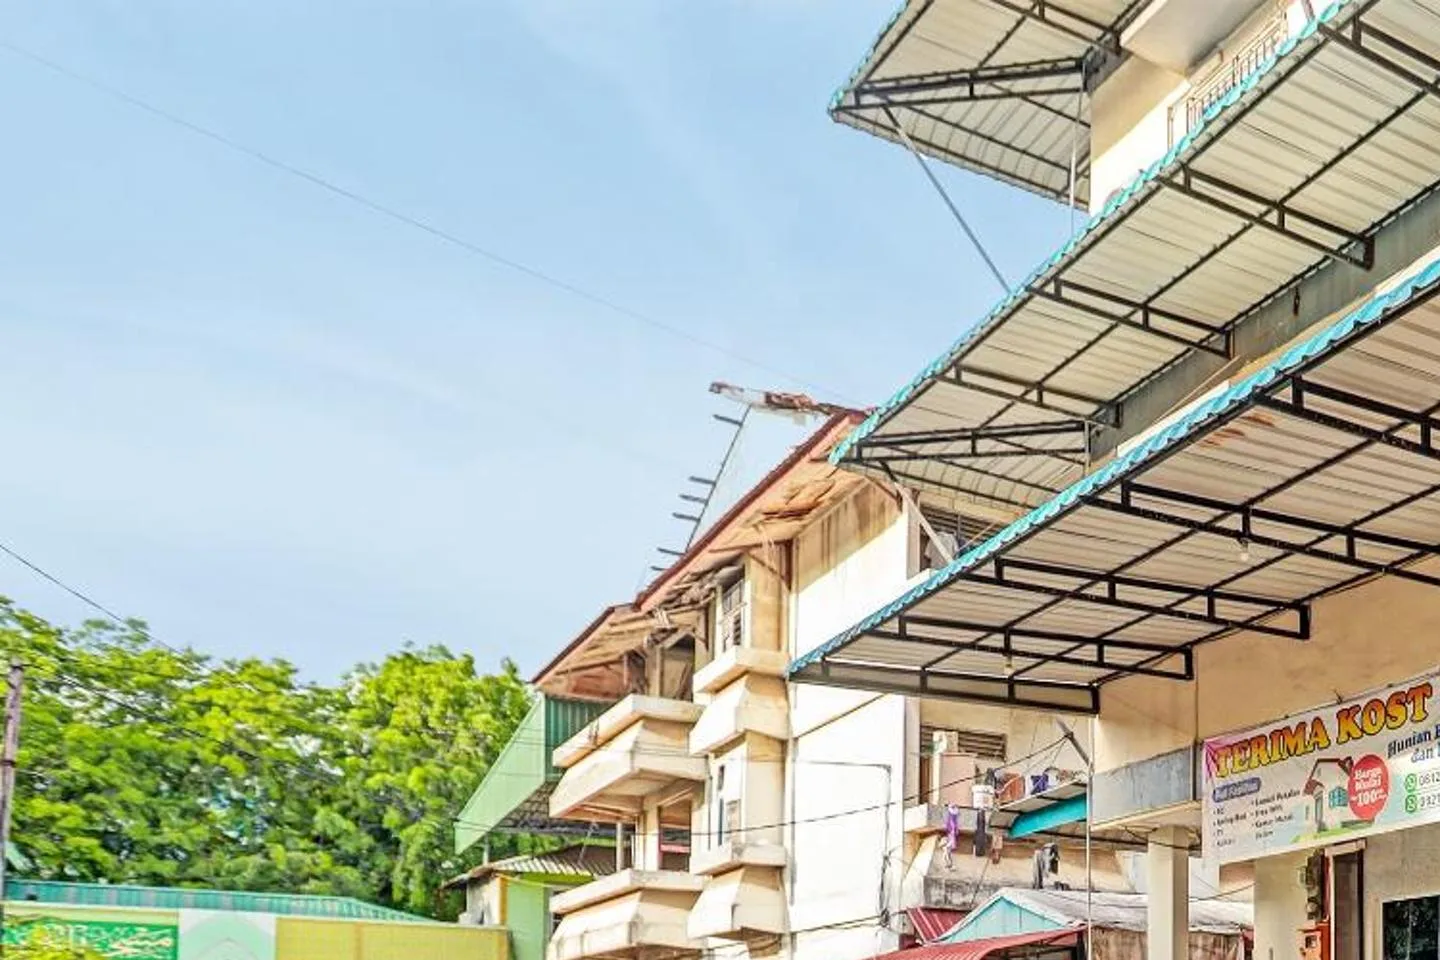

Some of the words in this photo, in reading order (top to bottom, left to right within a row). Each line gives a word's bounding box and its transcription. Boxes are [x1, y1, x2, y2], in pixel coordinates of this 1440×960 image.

[1213, 716, 1330, 778] TERIMA
[1336, 682, 1433, 745] KOST
[1387, 730, 1432, 759] Hunian
[1411, 747, 1434, 763] dan
